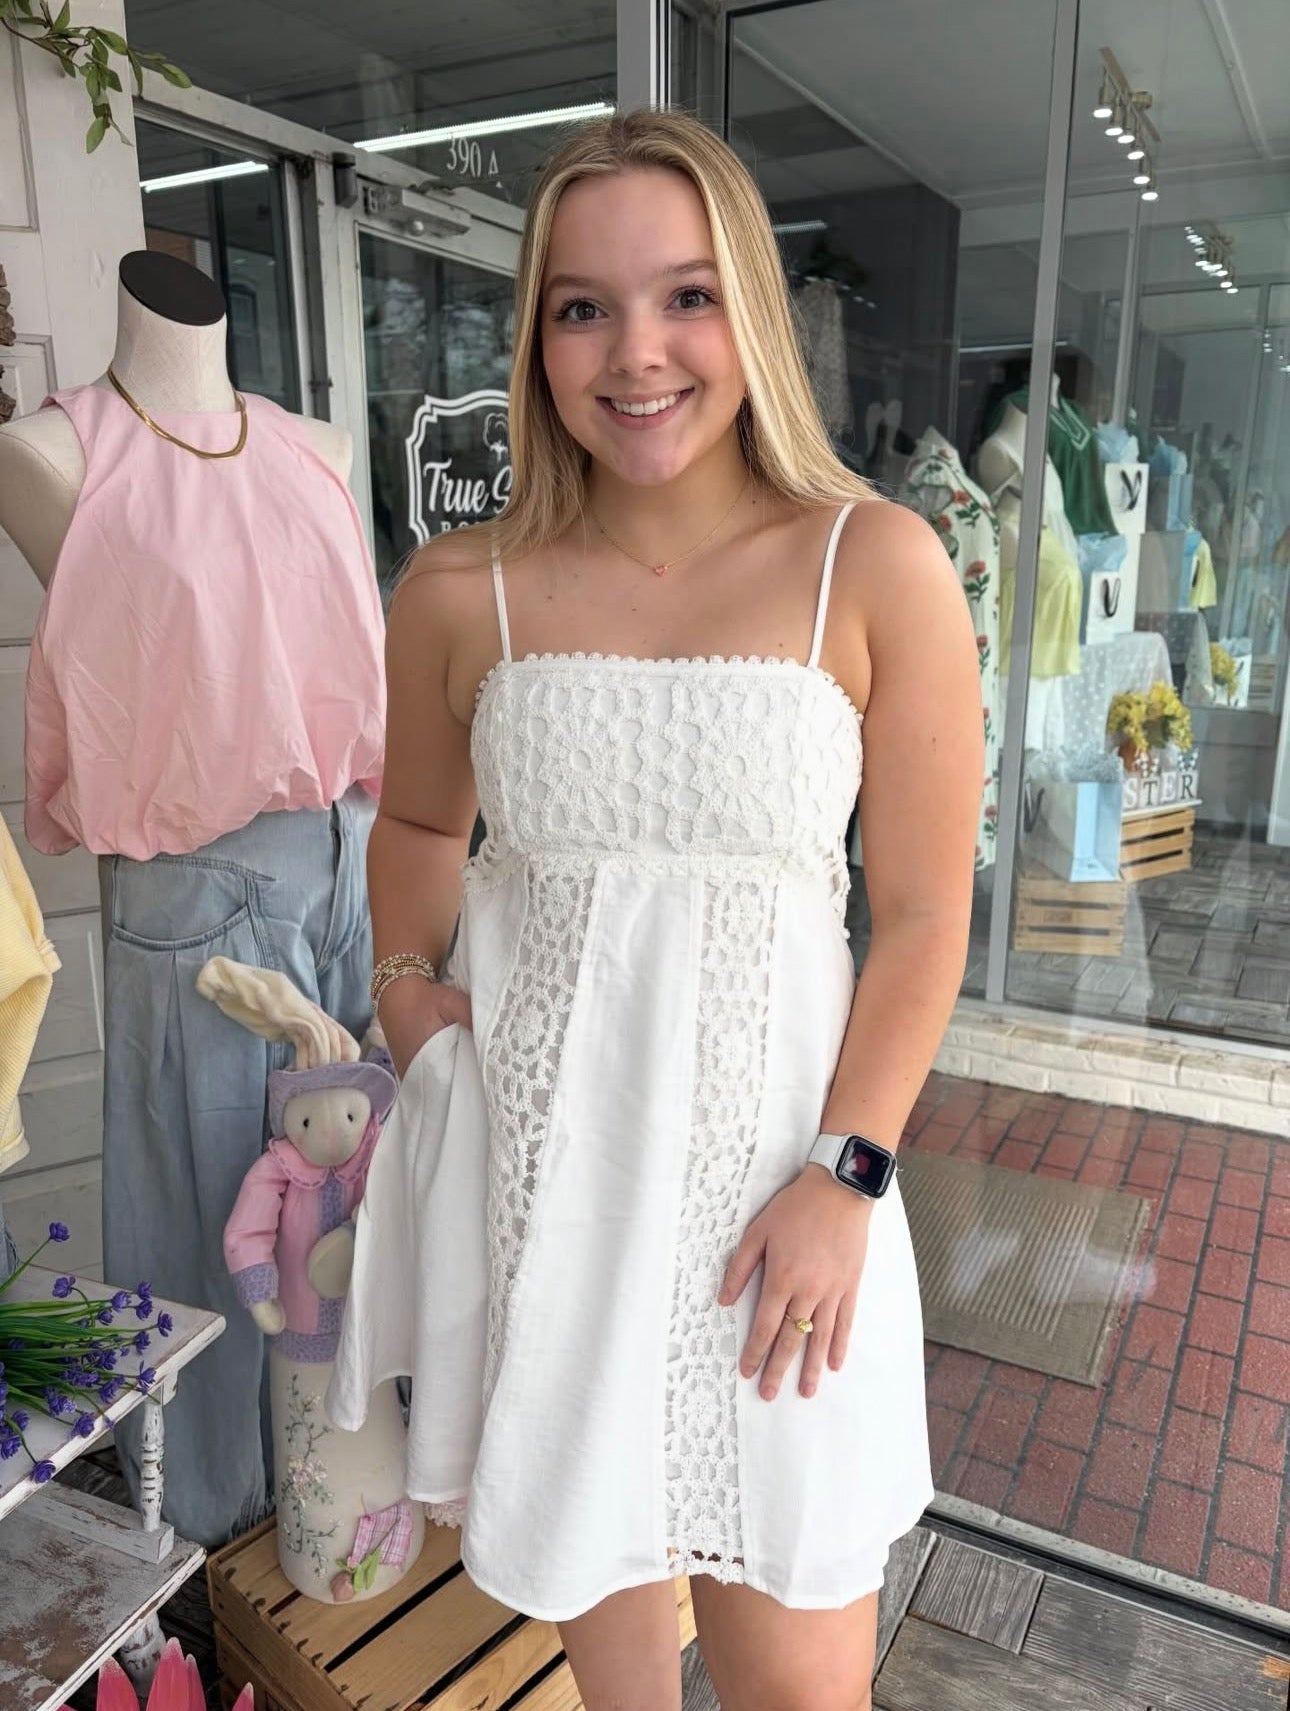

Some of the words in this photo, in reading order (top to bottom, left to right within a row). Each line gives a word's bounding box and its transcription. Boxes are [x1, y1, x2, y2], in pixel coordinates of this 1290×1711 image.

[446, 134, 482, 178] 390
[423, 457, 490, 513] True
[492, 465, 513, 514] S
[1122, 774, 1195, 808] STER
